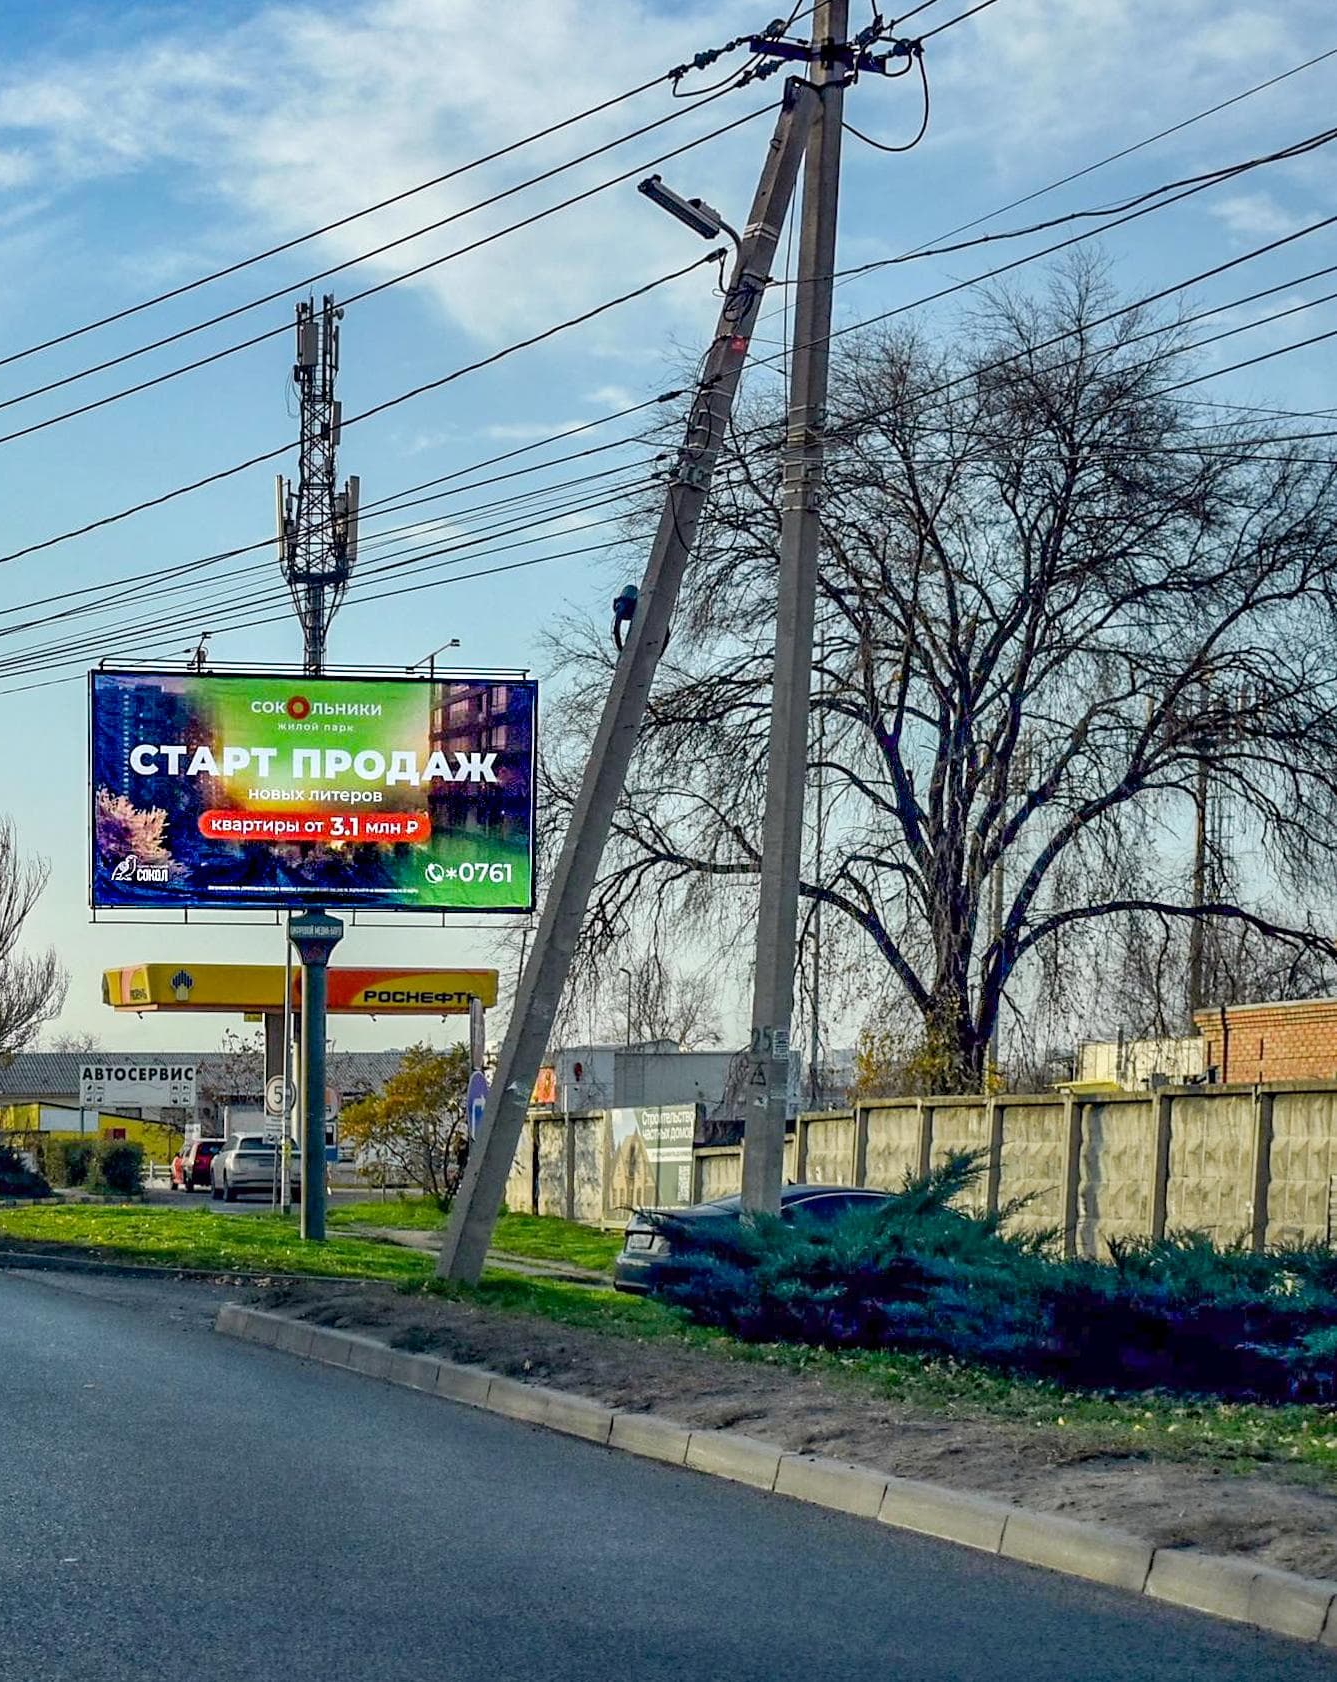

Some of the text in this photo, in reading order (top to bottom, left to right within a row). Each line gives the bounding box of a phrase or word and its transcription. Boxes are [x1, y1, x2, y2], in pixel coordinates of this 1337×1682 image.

[278, 722, 355, 733] жилой парк
[129, 744, 498, 787] СТАРТ ПРОДАЖ
[249, 788, 383, 804] новых литеров
[211, 817, 300, 835] квартиры
[304, 820, 324, 833] от
[330, 816, 359, 836] 3.1
[365, 821, 401, 834] млн
[137, 869, 168, 882] СОКОЛ
[363, 990, 480, 1004] РОСНЕФТЬ
[83, 1067, 194, 1081] АВТОСЕРВИС
